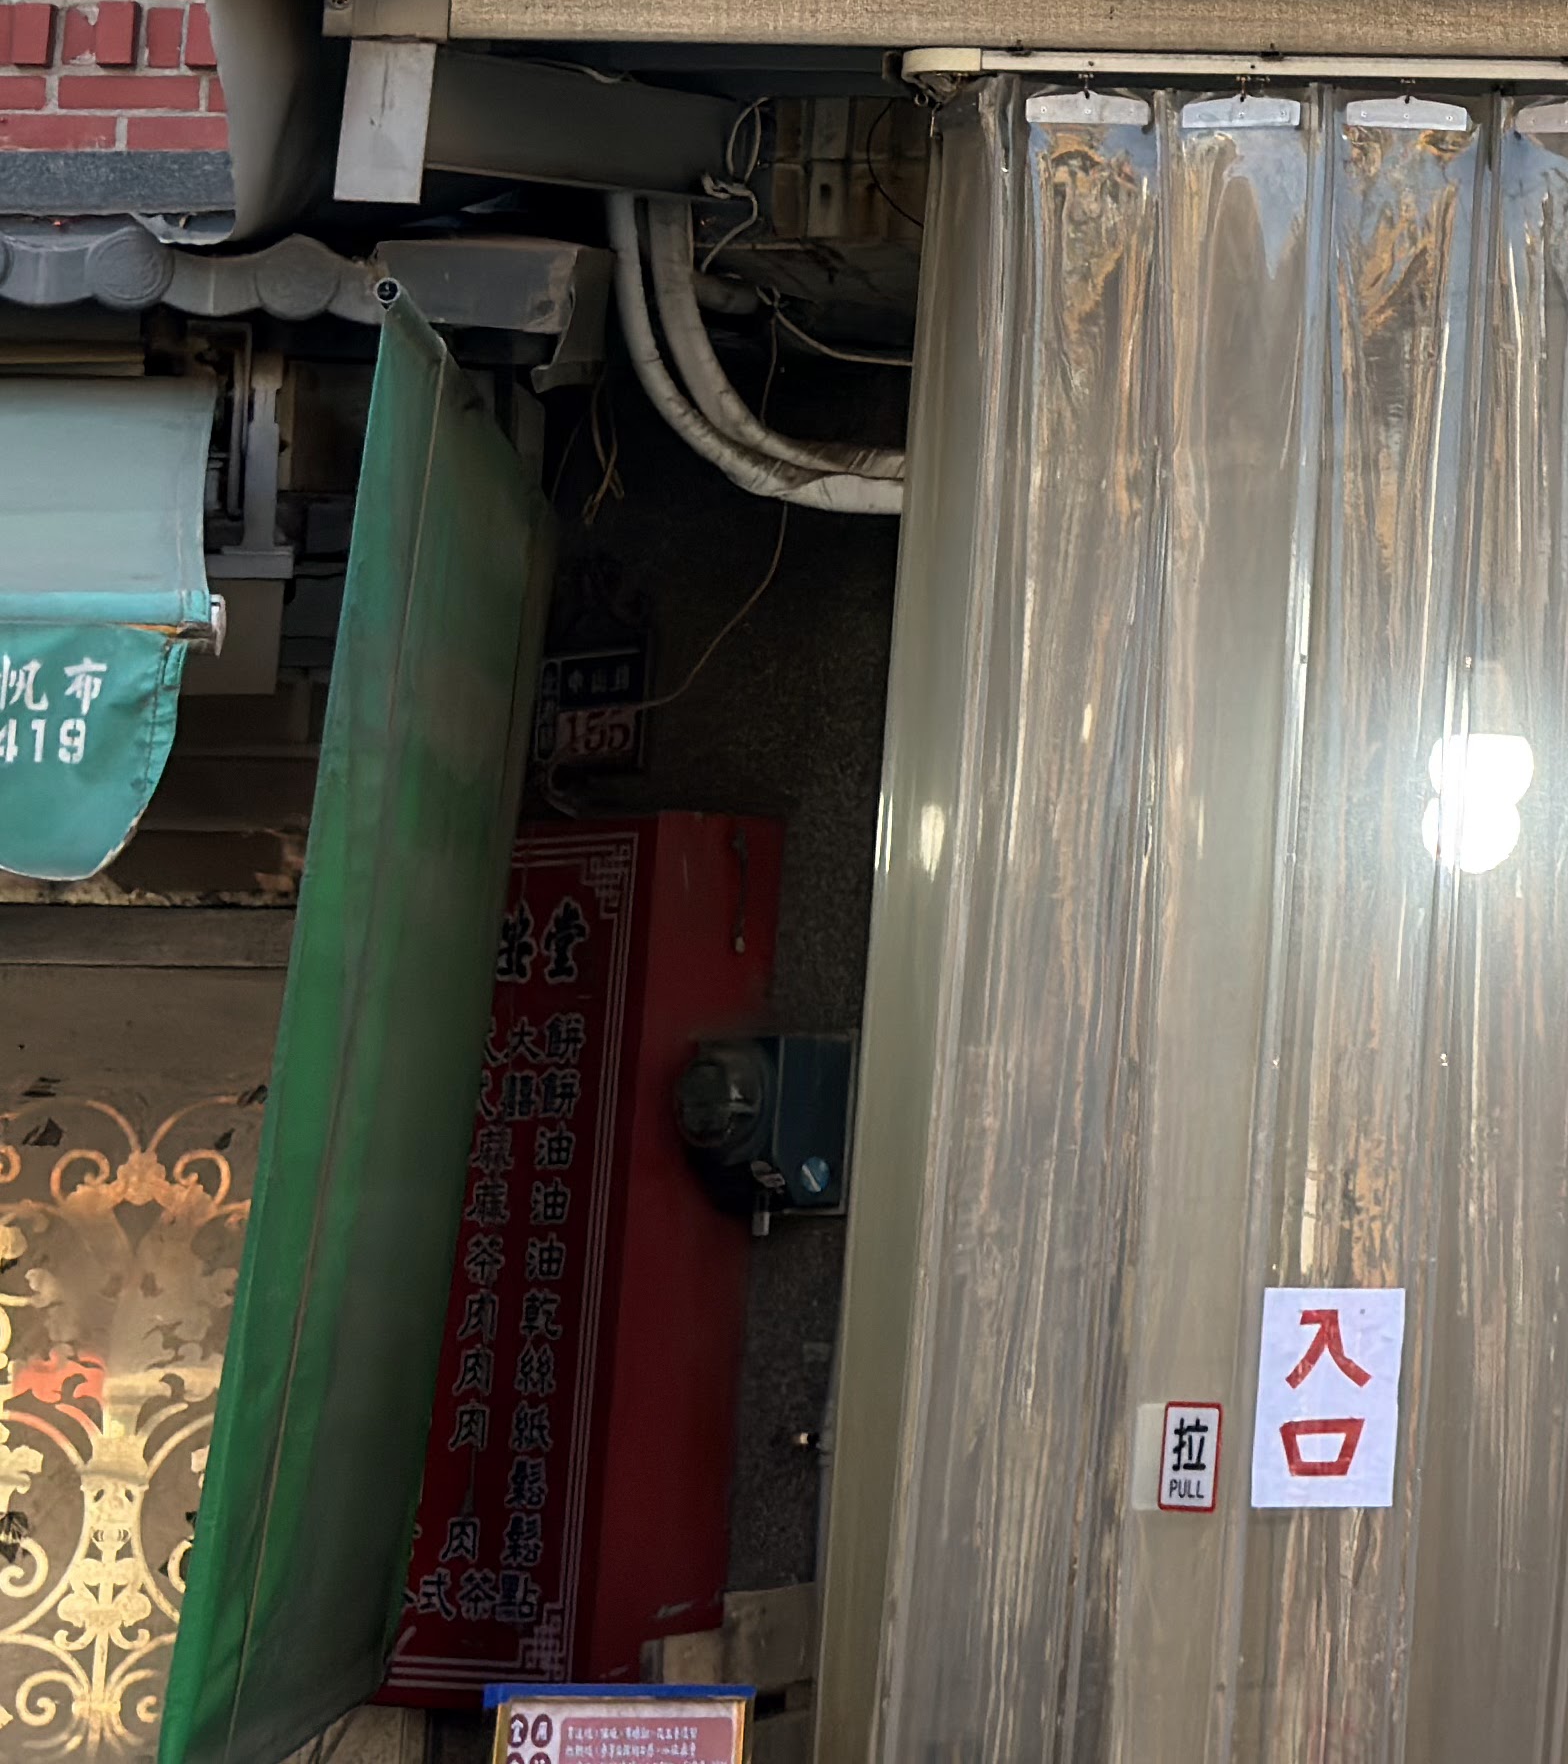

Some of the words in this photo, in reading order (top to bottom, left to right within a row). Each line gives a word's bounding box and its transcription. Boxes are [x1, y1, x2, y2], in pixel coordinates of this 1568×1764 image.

[1279, 1308, 1372, 1477] 入口
[1172, 1416, 1209, 1471] 拉
[1168, 1478, 1205, 1500] PULL
[403, 1567, 543, 1623] 式茶點
